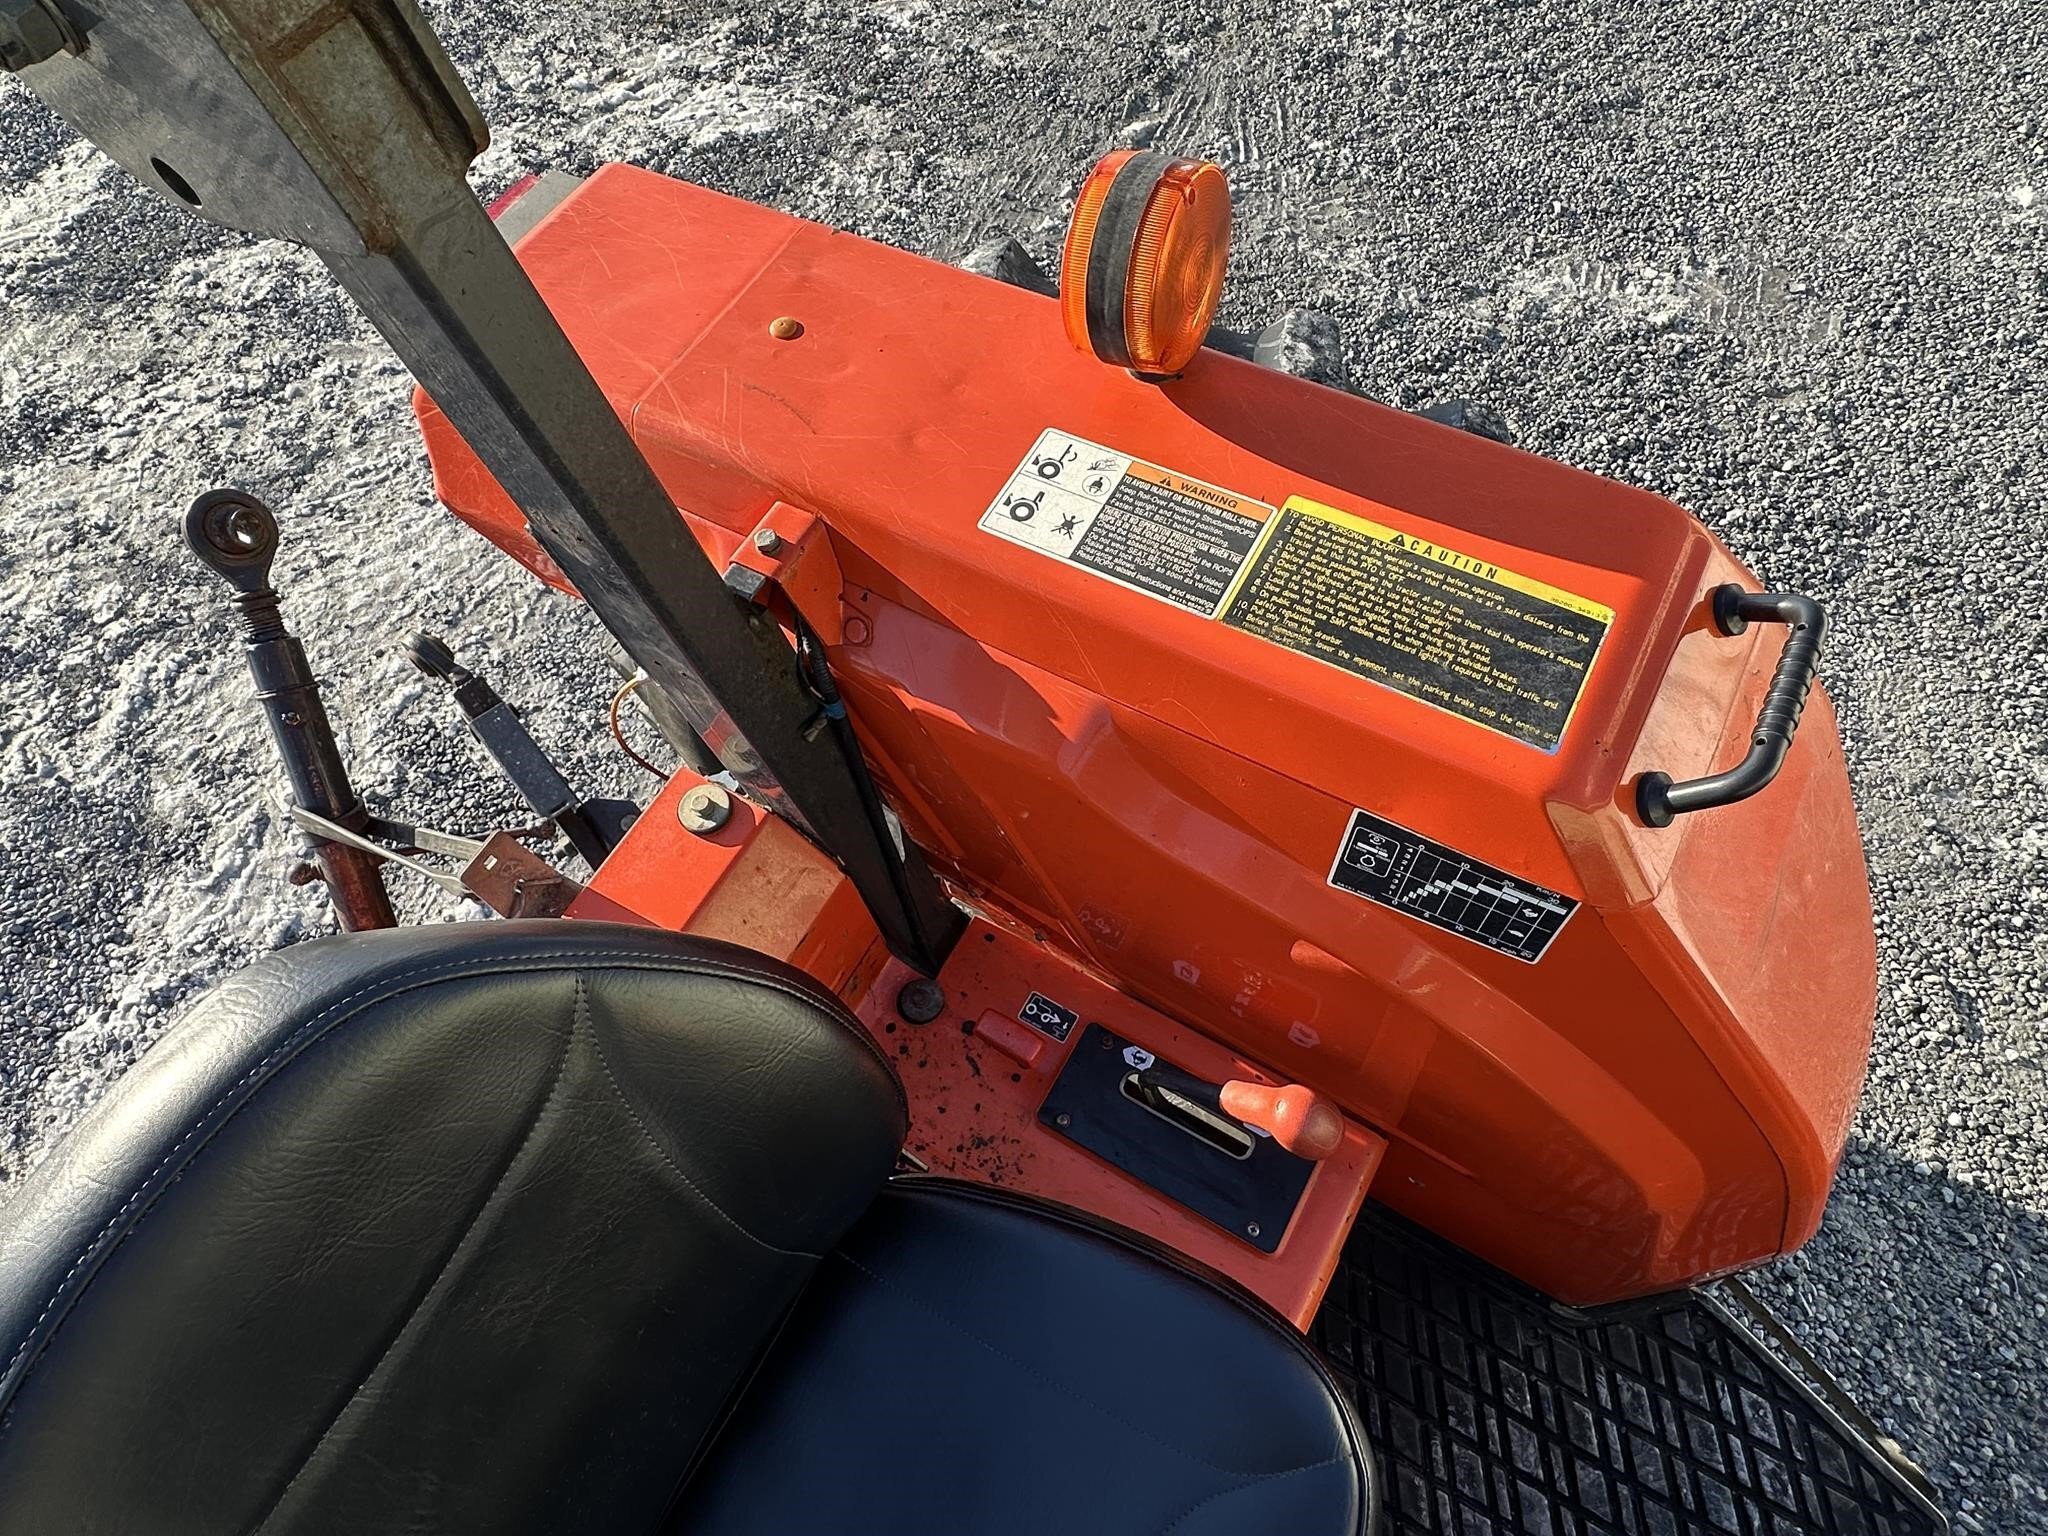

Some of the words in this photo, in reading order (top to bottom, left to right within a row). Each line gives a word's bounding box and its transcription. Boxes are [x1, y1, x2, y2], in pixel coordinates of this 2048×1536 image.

[1122, 494, 1133, 503] the
[1134, 499, 1158, 511] upright
[1158, 508, 1172, 517] and
[1172, 512, 1195, 525] locked
[1194, 522, 1223, 536] position.
[1123, 475, 1132, 483] TO
[1131, 478, 1150, 490] AVOID
[1150, 485, 1173, 497] INJURY
[1172, 493, 1182, 501] OR
[1181, 496, 1203, 509] DEATH
[1202, 504, 1221, 515] FROM
[1181, 482, 1237, 508] WARNING
[1110, 498, 1133, 510] Fasten
[1133, 507, 1153, 518] SEAT
[1153, 514, 1172, 525] BELT
[1172, 521, 1194, 534] before
[1195, 530, 1228, 547] operating.
[1288, 509, 1299, 518] TO
[1301, 515, 1324, 526] AVOID
[1327, 523, 1366, 542] PERSONAL
[1080, 544, 1112, 560] clearance
[1113, 557, 1135, 570] allows.
[1084, 537, 1103, 549] Raise
[1104, 546, 1118, 555] and
[1118, 551, 1133, 561] lock
[1133, 556, 1155, 569] ROPS
[1165, 570, 1183, 580] soon
[1194, 580, 1221, 595] vertical
[1088, 531, 1098, 540] Do
[1098, 536, 1110, 544] not
[1110, 541, 1126, 550] wear
[1126, 546, 1147, 558] SEAT
[1147, 554, 1166, 565] BELT
[1171, 563, 1193, 576] ROPS
[1193, 571, 1201, 579] is
[1091, 526, 1107, 536] only
[1108, 532, 1125, 542] when
[1126, 539, 1161, 557] absolutely
[1161, 553, 1197, 570] necessary.
[1096, 519, 1116, 531] Check
[1116, 527, 1127, 535] the
[1127, 532, 1159, 548] operating
[1159, 544, 1174, 553] area
[1174, 550, 1188, 558] and
[1200, 559, 1211, 568] the
[1211, 563, 1233, 576] ROPS
[1289, 536, 1312, 549] tractor
[1314, 546, 1328, 554] and
[1329, 550, 1344, 560] that
[1346, 557, 1358, 566] the
[1359, 561, 1377, 572] PTO
[1378, 568, 1385, 576] is
[1297, 520, 1316, 532] Read
[1316, 529, 1330, 537] and
[1331, 534, 1369, 551] understand
[1370, 547, 1381, 556] the
[1383, 553, 1418, 570] operator's
[1420, 567, 1445, 579] manual
[1446, 575, 1469, 588] before
[1471, 586, 1504, 602] operation.
[1410, 540, 1497, 578] CAUTION
[1284, 543, 1295, 552] Do
[1296, 549, 1308, 557] not
[1310, 554, 1328, 563] allow
[1328, 561, 1367, 578] passengers
[1381, 579, 1392, 588] the
[1395, 584, 1420, 597] tractor
[1432, 599, 1446, 609] any
[1448, 604, 1464, 615] time.
[1293, 527, 1316, 541] Before
[1318, 538, 1345, 553] starting
[1346, 548, 1358, 557] the
[1385, 563, 1403, 573] make
[1406, 571, 1422, 580] sure
[1424, 576, 1439, 587] that
[1441, 584, 1473, 599] everyone
[1475, 595, 1483, 603] is
[1503, 607, 1520, 617] safe
[1523, 613, 1553, 629] distance
[1557, 625, 1573, 636] from
[1576, 633, 1589, 642] the
[1272, 566, 1289, 578] Keep
[1302, 578, 1326, 591] shields
[1337, 592, 1356, 602] place
[1358, 599, 1373, 608] and
[1373, 605, 1390, 616] stay
[1392, 612, 1410, 625] away
[1413, 619, 1429, 630] from
[1442, 631, 1468, 646] moving
[1469, 641, 1490, 654] parts.
[1280, 550, 1304, 564] Before
[1305, 561, 1332, 576] allowing
[1332, 571, 1351, 581] other
[1352, 579, 1375, 591] people
[1377, 586, 1385, 594] to
[1386, 591, 1400, 600] use
[1402, 596, 1414, 605] the
[1444, 611, 1461, 623] have
[1464, 619, 1481, 630] them
[1483, 627, 1501, 638] read
[1502, 633, 1515, 643] the
[1517, 640, 1554, 658] operator's
